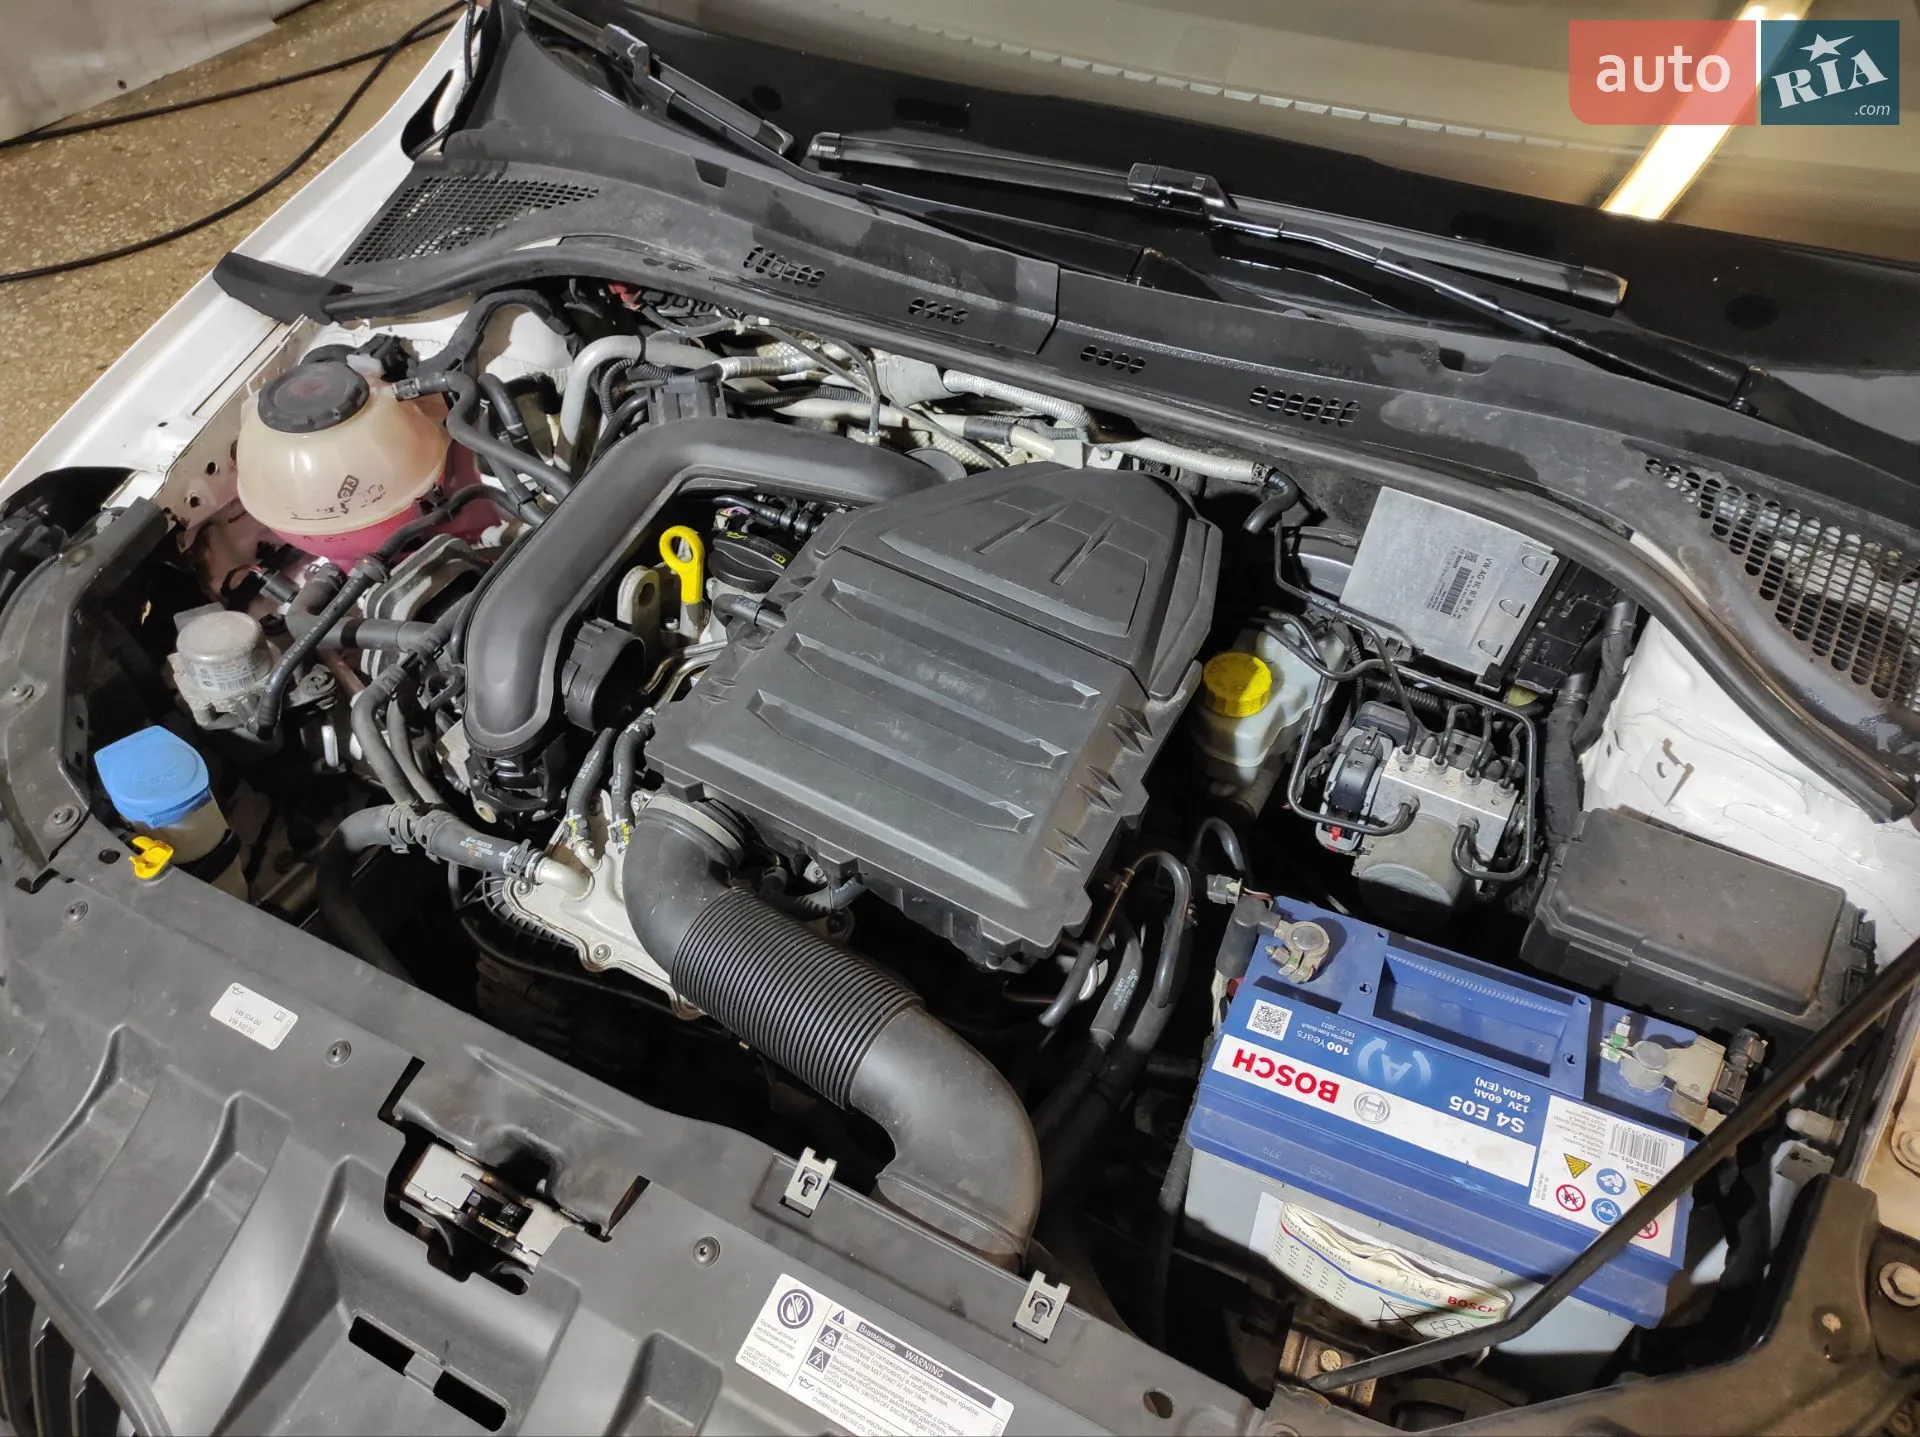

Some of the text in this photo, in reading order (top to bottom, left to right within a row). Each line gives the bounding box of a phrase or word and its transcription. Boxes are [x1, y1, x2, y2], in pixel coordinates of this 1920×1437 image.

[228, 1016, 239, 1025] VW
[234, 1008, 245, 1017] VW
[1300, 1022, 1317, 1031] Bosch
[1316, 1028, 1330, 1036] from
[1320, 1021, 1336, 1030] 2022
[1340, 1029, 1355, 1037] 1922
[1294, 1029, 1351, 1056] 100 Years
[1231, 1046, 1340, 1105] BOSCH
[1472, 1087, 1529, 1113] 12V 60Ah
[1473, 1075, 1531, 1103] 640A (EN)
[1446, 1094, 1491, 1121] E05
[1493, 1110, 1526, 1133] S4
[857, 1323, 945, 1378] Внимание WARNING
